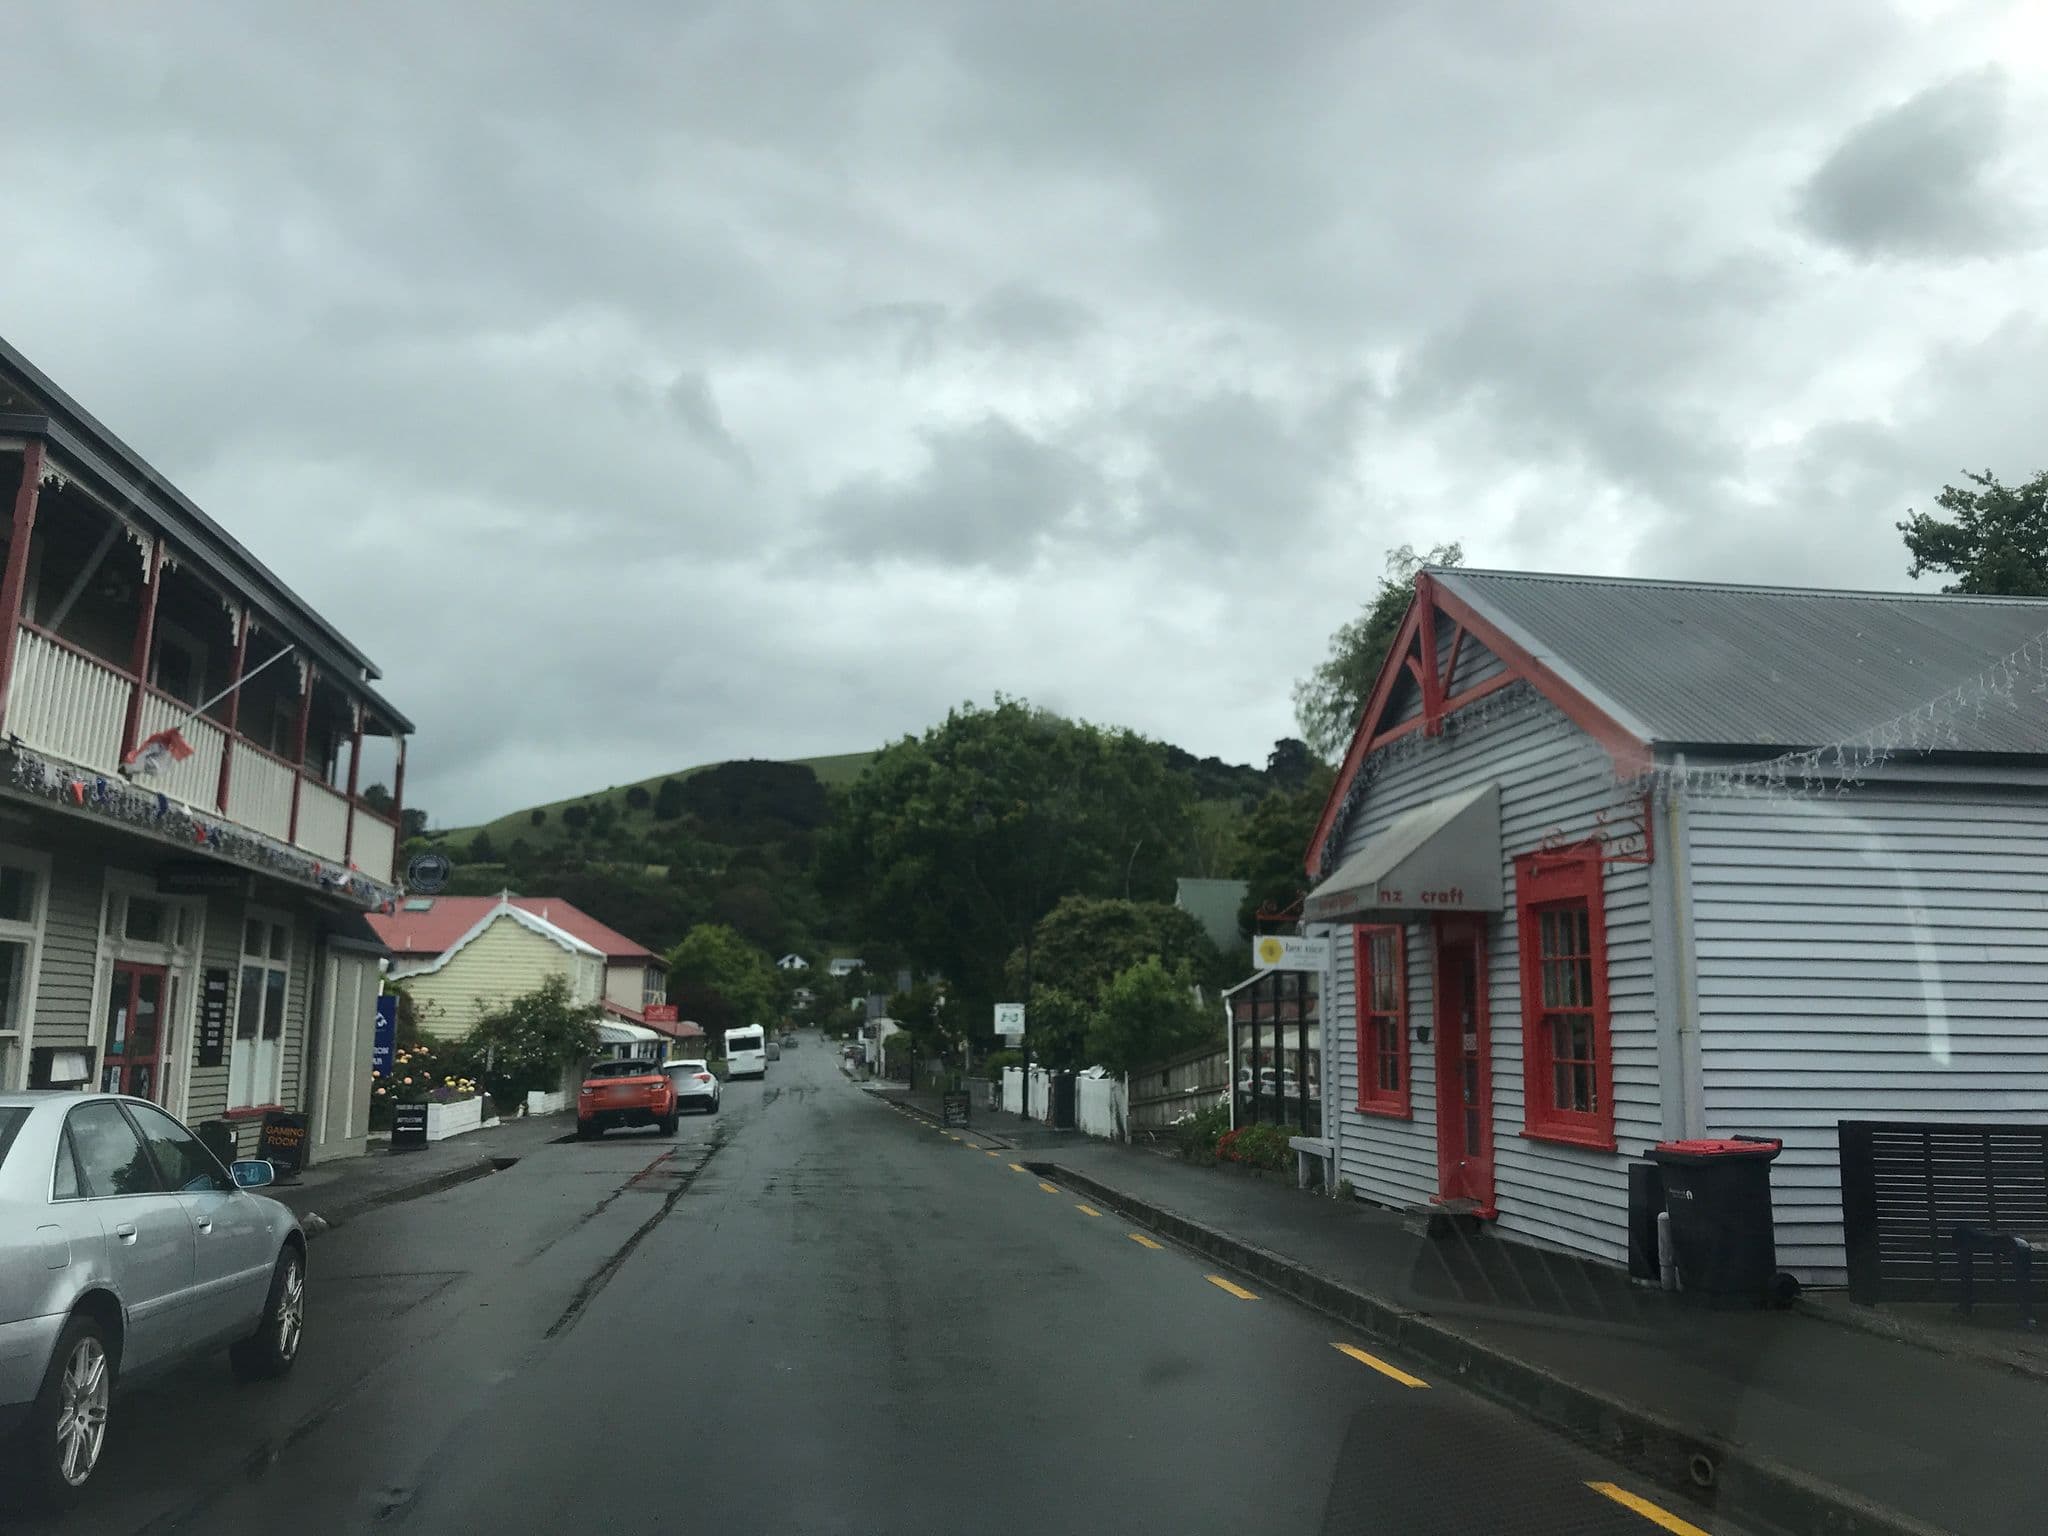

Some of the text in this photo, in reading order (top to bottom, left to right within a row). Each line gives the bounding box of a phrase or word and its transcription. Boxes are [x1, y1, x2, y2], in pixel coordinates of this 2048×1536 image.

[1380, 886, 1464, 905] nz craft
[265, 1125, 305, 1137] GAMING
[267, 1135, 298, 1147] ROOM
